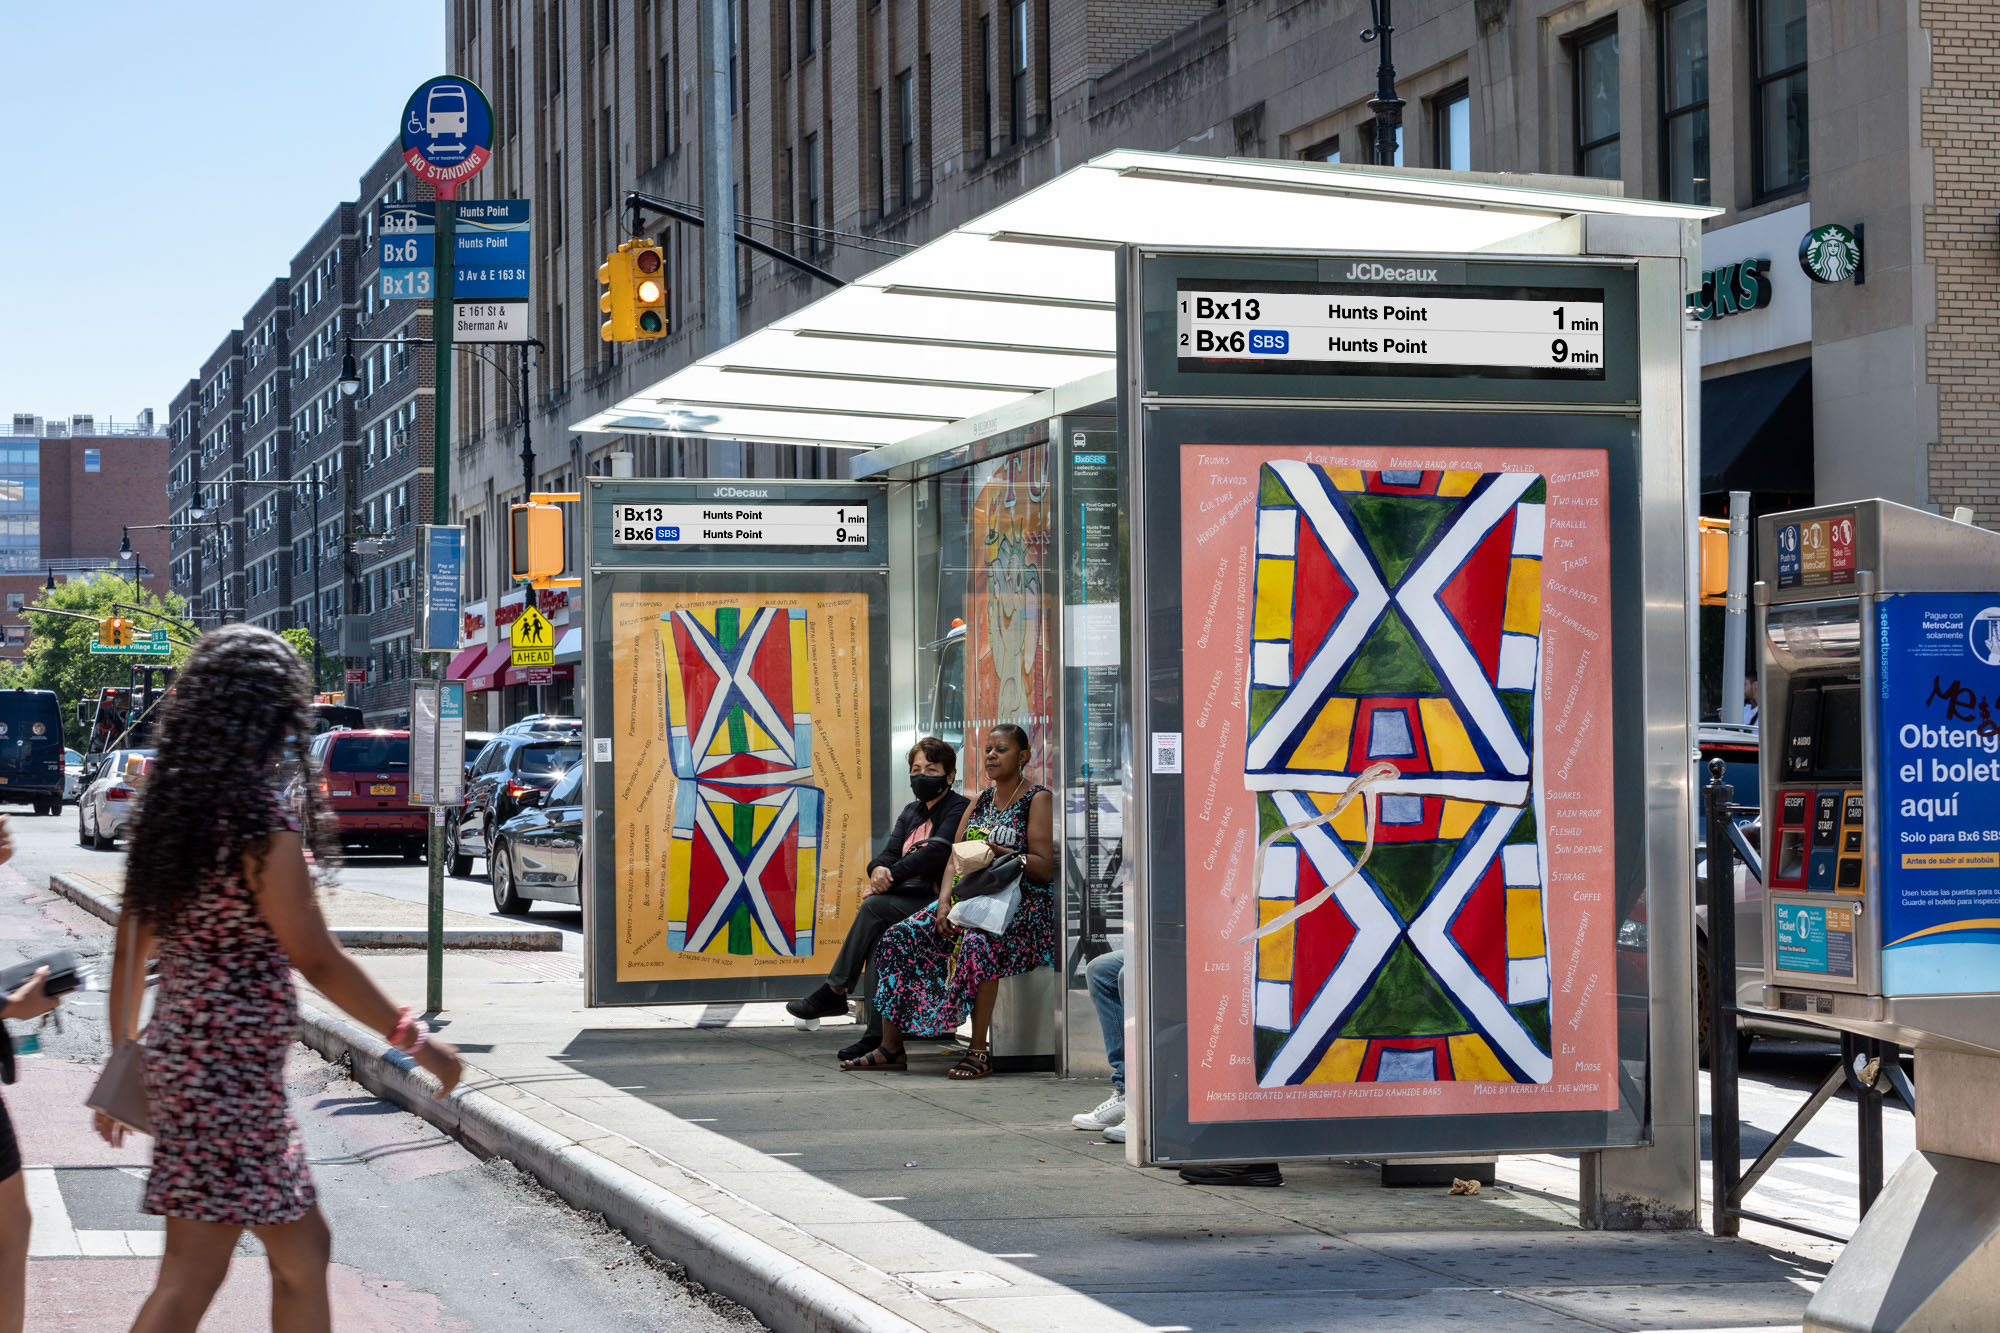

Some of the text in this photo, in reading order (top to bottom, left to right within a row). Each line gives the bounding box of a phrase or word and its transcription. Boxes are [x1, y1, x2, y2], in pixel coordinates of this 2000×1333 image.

[409, 152, 481, 180] NO STANDING
[460, 206, 508, 218] Hunts Point
[384, 210, 418, 233] Bx6
[458, 238, 508, 248] Hunts Point
[384, 239, 418, 262] Bx6
[458, 270, 526, 281] 3 Av & E 163 St
[1346, 263, 1438, 282] JCDecaux
[383, 271, 430, 294] Bx13
[459, 306, 506, 317] E 161 St &
[1180, 298, 1599, 332] 1 Bx13 Hunts Point 1 min
[458, 320, 508, 332] Sherman Av
[1180, 330, 1599, 363] 2 Bx6 SBS Hunts Point 9 min
[1197, 454, 1230, 465] TRUNKS
[1306, 452, 1379, 468] A CULTURE SYMBOL
[1390, 457, 1483, 470] NARROW BAND OF COLOR
[1502, 462, 1535, 472] SKILLED
[1210, 474, 1248, 486] TRAVOIS
[1550, 468, 1600, 484] CONTAINERS
[713, 488, 768, 498] JCDecaux
[1552, 495, 1599, 506] TWO HALVES
[624, 508, 662, 522] Bx13
[704, 510, 732, 520] Hunts
[736, 510, 762, 520] Point
[836, 509, 845, 523] 1
[848, 515, 864, 524] min
[1550, 518, 1587, 529] PARALLEL
[624, 528, 654, 540] Bx6
[658, 530, 677, 538] SBS
[704, 530, 732, 540] Hunts
[736, 530, 762, 540] Point
[836, 528, 846, 542] 9
[848, 534, 864, 542] min
[1803, 529, 1810, 546] 2
[1832, 526, 1838, 542] 3
[1554, 537, 1574, 548] FINE
[1780, 532, 1785, 548] 1
[1780, 554, 1790, 562] Push
[1803, 551, 1816, 560] Insert
[1833, 549, 1844, 558] Take
[1562, 556, 1589, 572] TRADE
[1780, 564, 1790, 572] start
[1803, 560, 1826, 570] MetroCard
[1833, 558, 1846, 567] Ticket
[1547, 579, 1598, 604] ROCK PAINTS
[1924, 612, 1948, 620] Pague
[516, 652, 550, 662] AHEAD
[1798, 736, 1811, 746] AUDIO
[1900, 759, 1922, 782] el
[1546, 790, 1580, 800] SQUARES
[1784, 798, 1804, 806] RECEIPT
[1822, 798, 1834, 807] PUSH
[1900, 792, 1959, 821] aquí
[1557, 809, 1602, 818] RAIN PROOF
[1824, 810, 1830, 818] TO
[1848, 808, 1862, 818] CARD
[1818, 821, 1834, 830] START
[1900, 830, 2000, 844] Solo para Bx6 SB
[1552, 872, 1586, 882] STORAGE
[1574, 891, 1601, 902] COFFEE
[1778, 908, 1788, 918] Get
[1779, 920, 1796, 931] Ticket
[1779, 932, 1792, 943] Here
[1204, 961, 1230, 972] LINES
[1562, 1043, 1576, 1054] ELK
[1575, 1061, 1600, 1072] MOOSE
[1206, 1088, 1442, 1102] HORSES DECORATED WITH BRIGHTLY PAINTED RAWHIDE BAGS
